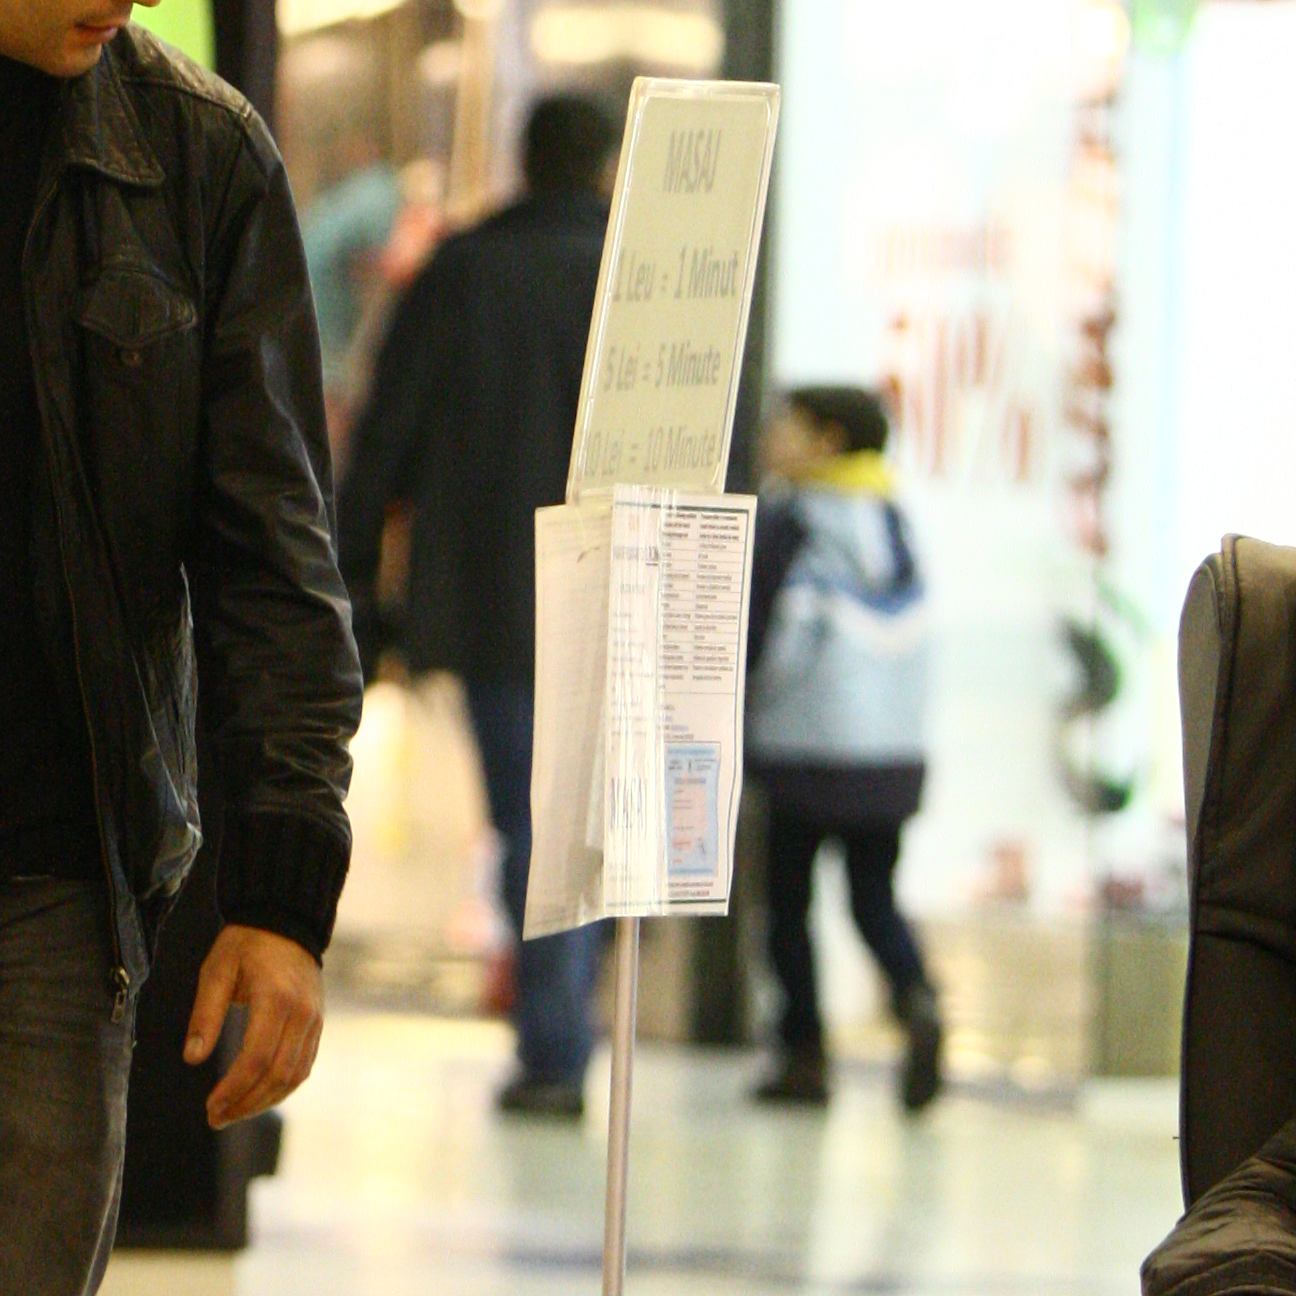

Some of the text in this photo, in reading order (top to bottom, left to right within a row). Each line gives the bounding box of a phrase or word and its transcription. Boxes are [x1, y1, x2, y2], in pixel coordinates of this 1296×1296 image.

[688, 245, 739, 299] Minut
[666, 339, 722, 387] Minute
[663, 425, 716, 470] Minute
